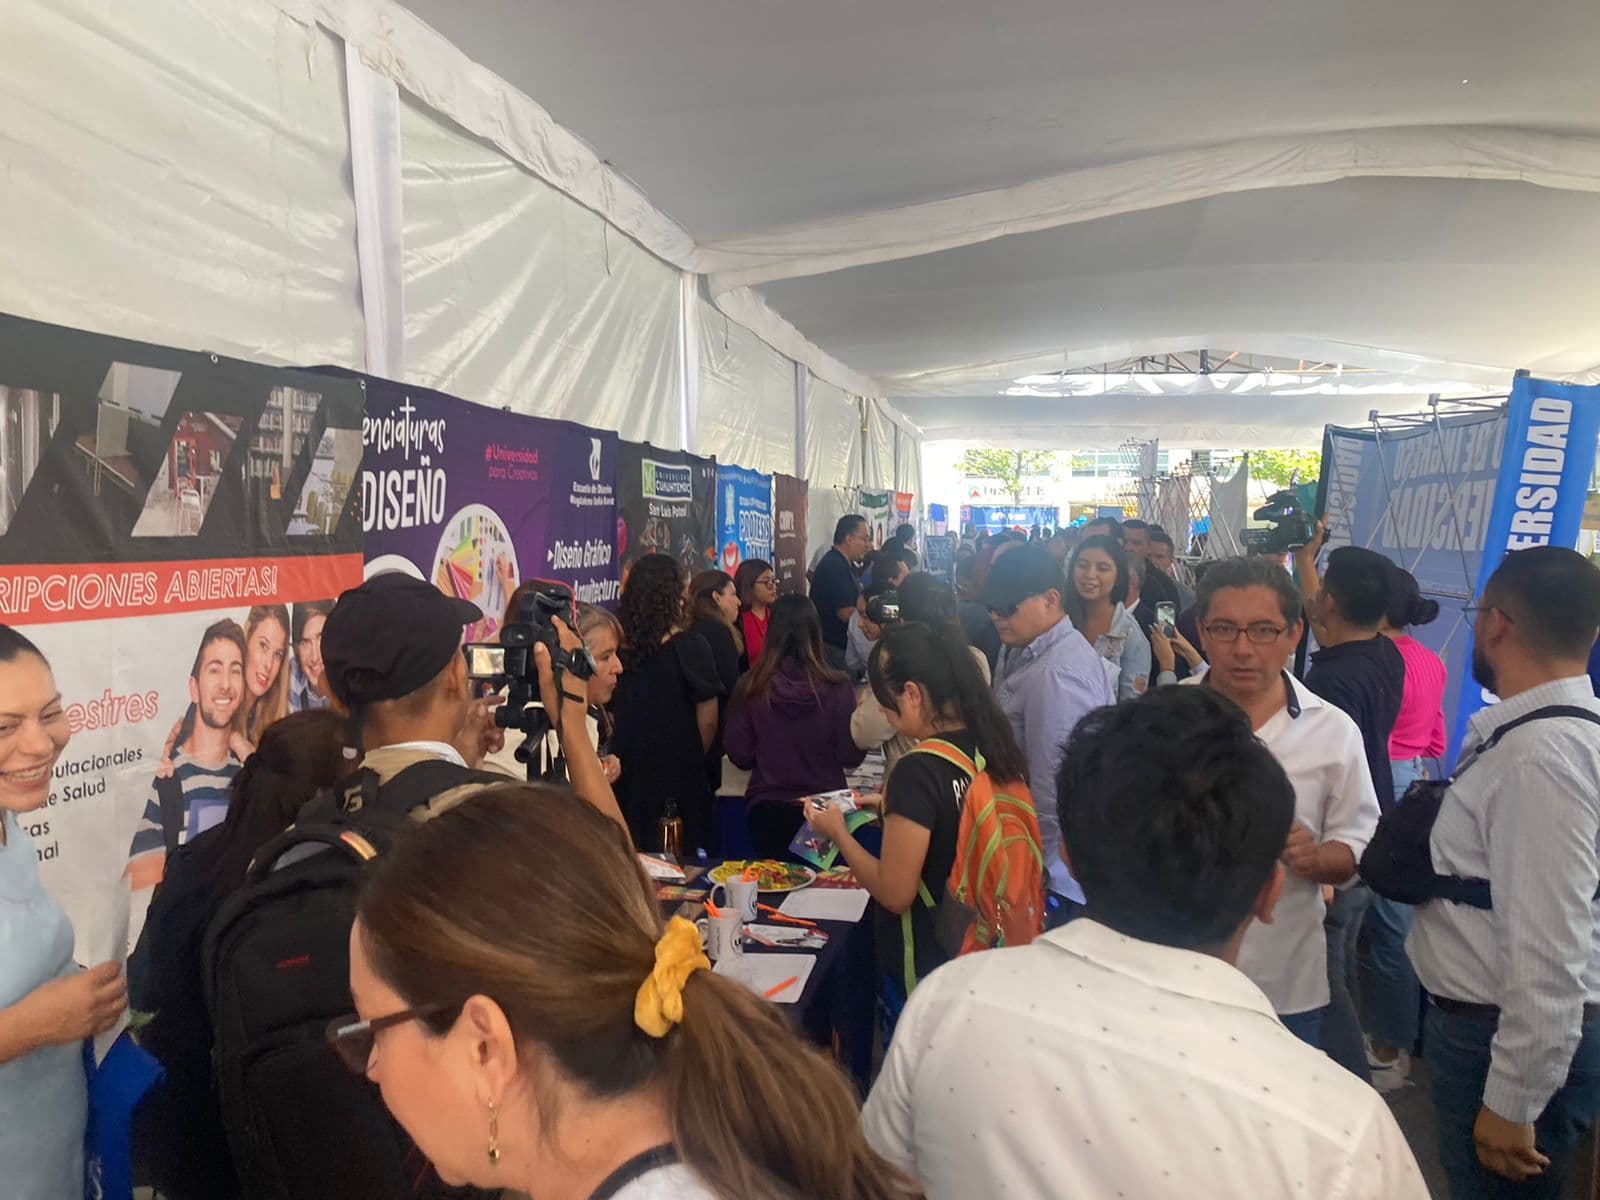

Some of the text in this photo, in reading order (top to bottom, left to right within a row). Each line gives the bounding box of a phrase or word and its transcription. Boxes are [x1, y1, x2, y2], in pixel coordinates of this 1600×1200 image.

[362, 396, 445, 461] enciaturas
[362, 455, 446, 532] DISEÑO
[553, 538, 612, 570] Diseño Gráfico
[0, 565, 278, 614] RIPCIONES ABIERTAS!
[64, 688, 160, 735] estres
[51, 747, 143, 779] utacionales
[63, 777, 106, 802] Salud
[23, 821, 50, 838] as
